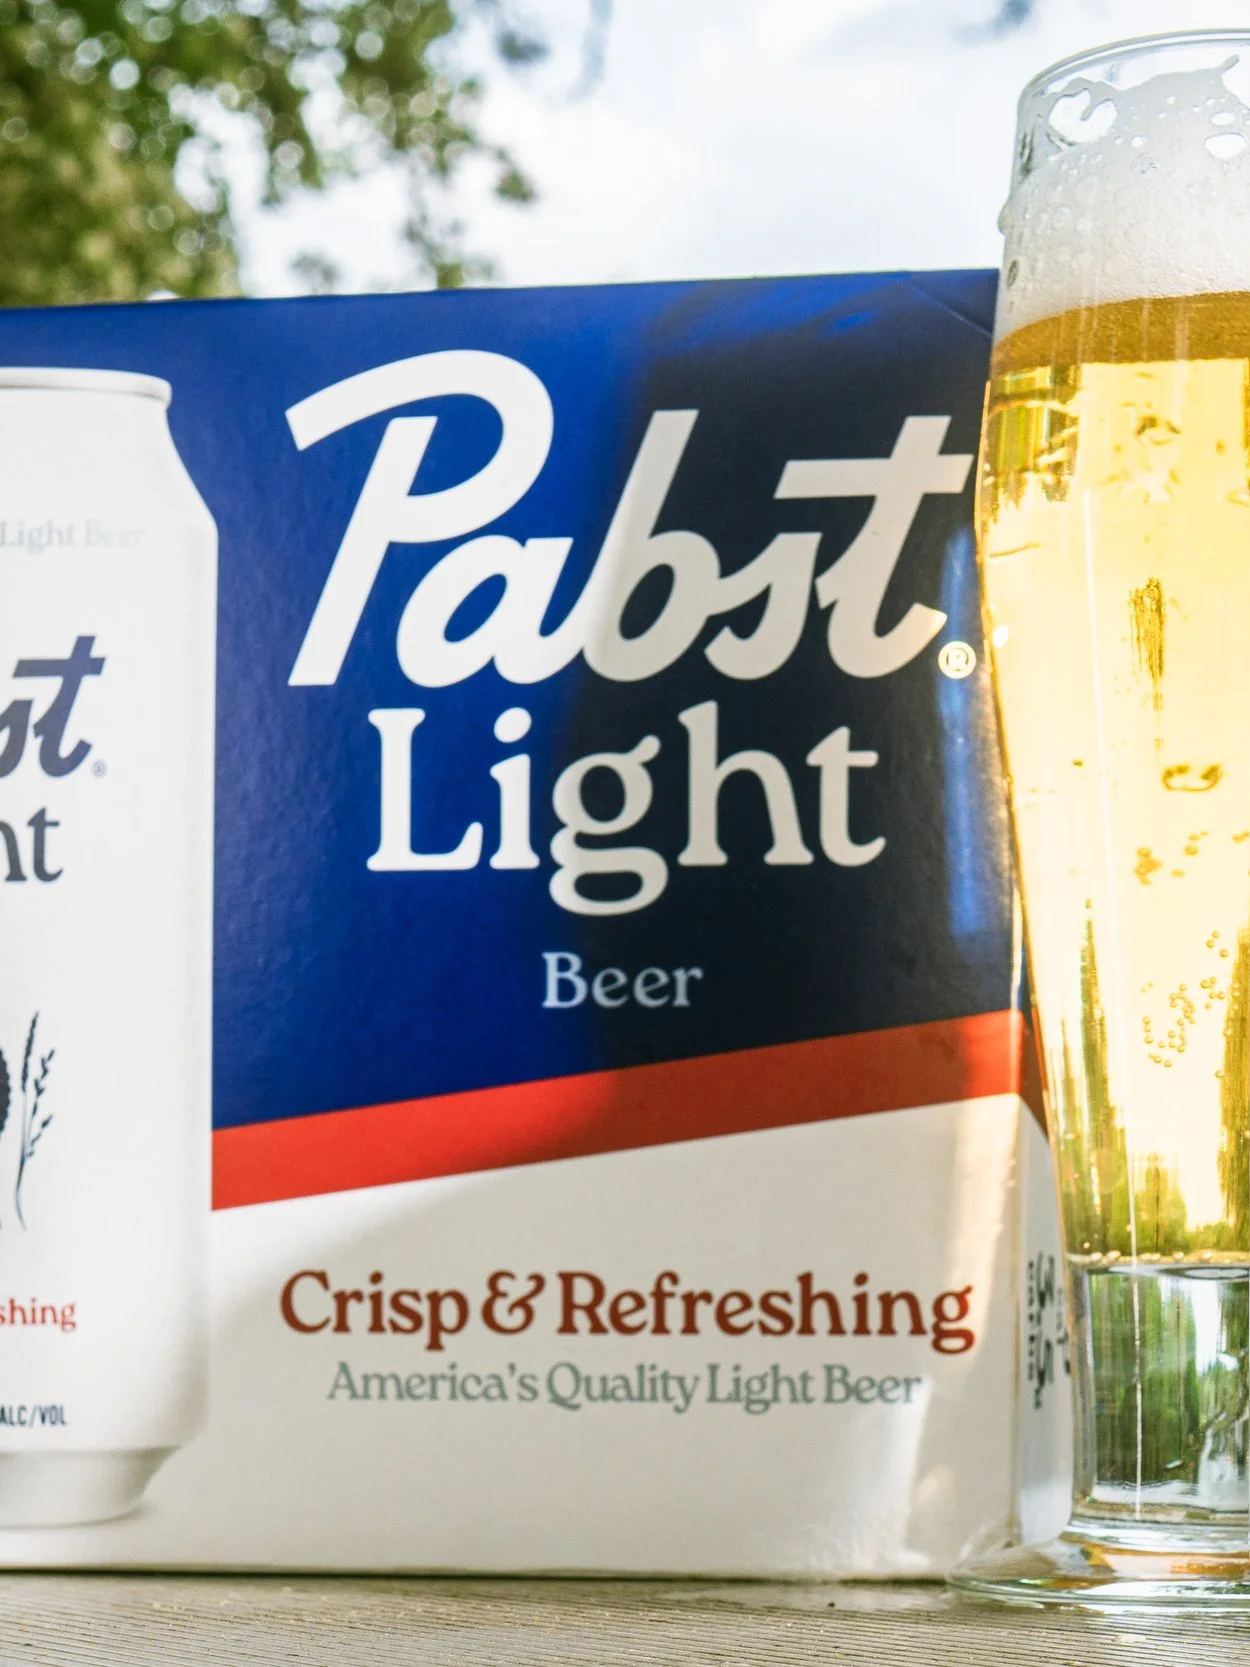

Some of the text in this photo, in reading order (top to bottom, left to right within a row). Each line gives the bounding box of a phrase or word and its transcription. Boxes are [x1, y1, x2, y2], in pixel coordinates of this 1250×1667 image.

[0, 517, 77, 555] Light
[367, 701, 886, 916] Light
[541, 951, 703, 1008] Beer
[280, 1269, 469, 1351] Crisp
[481, 1270, 546, 1335] &
[556, 1270, 976, 1355] Refreshing
[327, 1361, 922, 1415] America's Quality Light Beer
